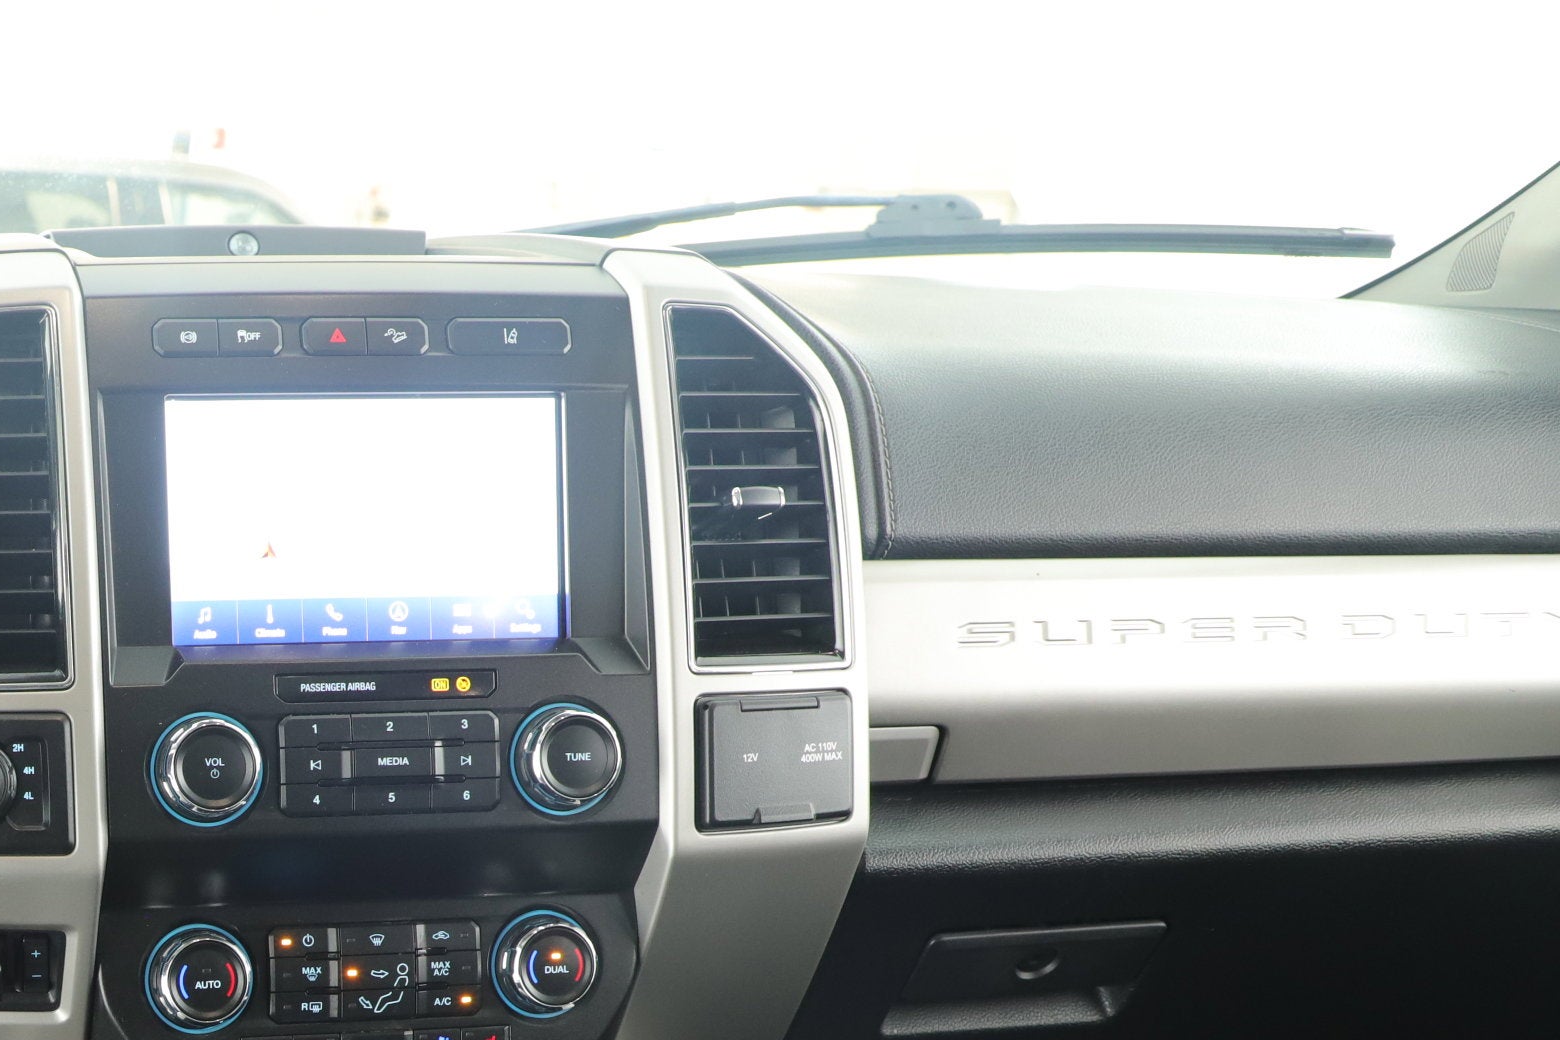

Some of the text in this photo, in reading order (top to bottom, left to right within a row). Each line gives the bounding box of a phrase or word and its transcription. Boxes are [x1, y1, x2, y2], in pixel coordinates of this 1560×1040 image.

[246, 332, 260, 340] OFF
[956, 610, 1560, 648] SUPER DUT
[300, 681, 376, 693] PASSENGER AIRBAG
[434, 680, 446, 690] ON
[311, 724, 318, 734] 1
[386, 721, 394, 732] 2
[461, 719, 469, 730] 3
[12, 743, 24, 752] 2H
[804, 742, 838, 752] AC 110V
[205, 757, 225, 767] VOL
[378, 757, 410, 767] MEDIA
[565, 752, 592, 762] TUNE
[743, 753, 759, 763] 12V
[800, 751, 843, 763] 400W MAX
[23, 766, 35, 775] 4H
[23, 792, 34, 800] 4L
[313, 795, 320, 805] 4
[388, 792, 395, 803] 5
[463, 790, 470, 800] 6
[431, 961, 451, 969] MAX
[544, 965, 570, 974] DUAL
[301, 966, 322, 975] MAX
[433, 968, 450, 976] A/C
[194, 980, 222, 990] AUTO
[301, 1002, 308, 1011] R
[434, 997, 452, 1006] A/C
